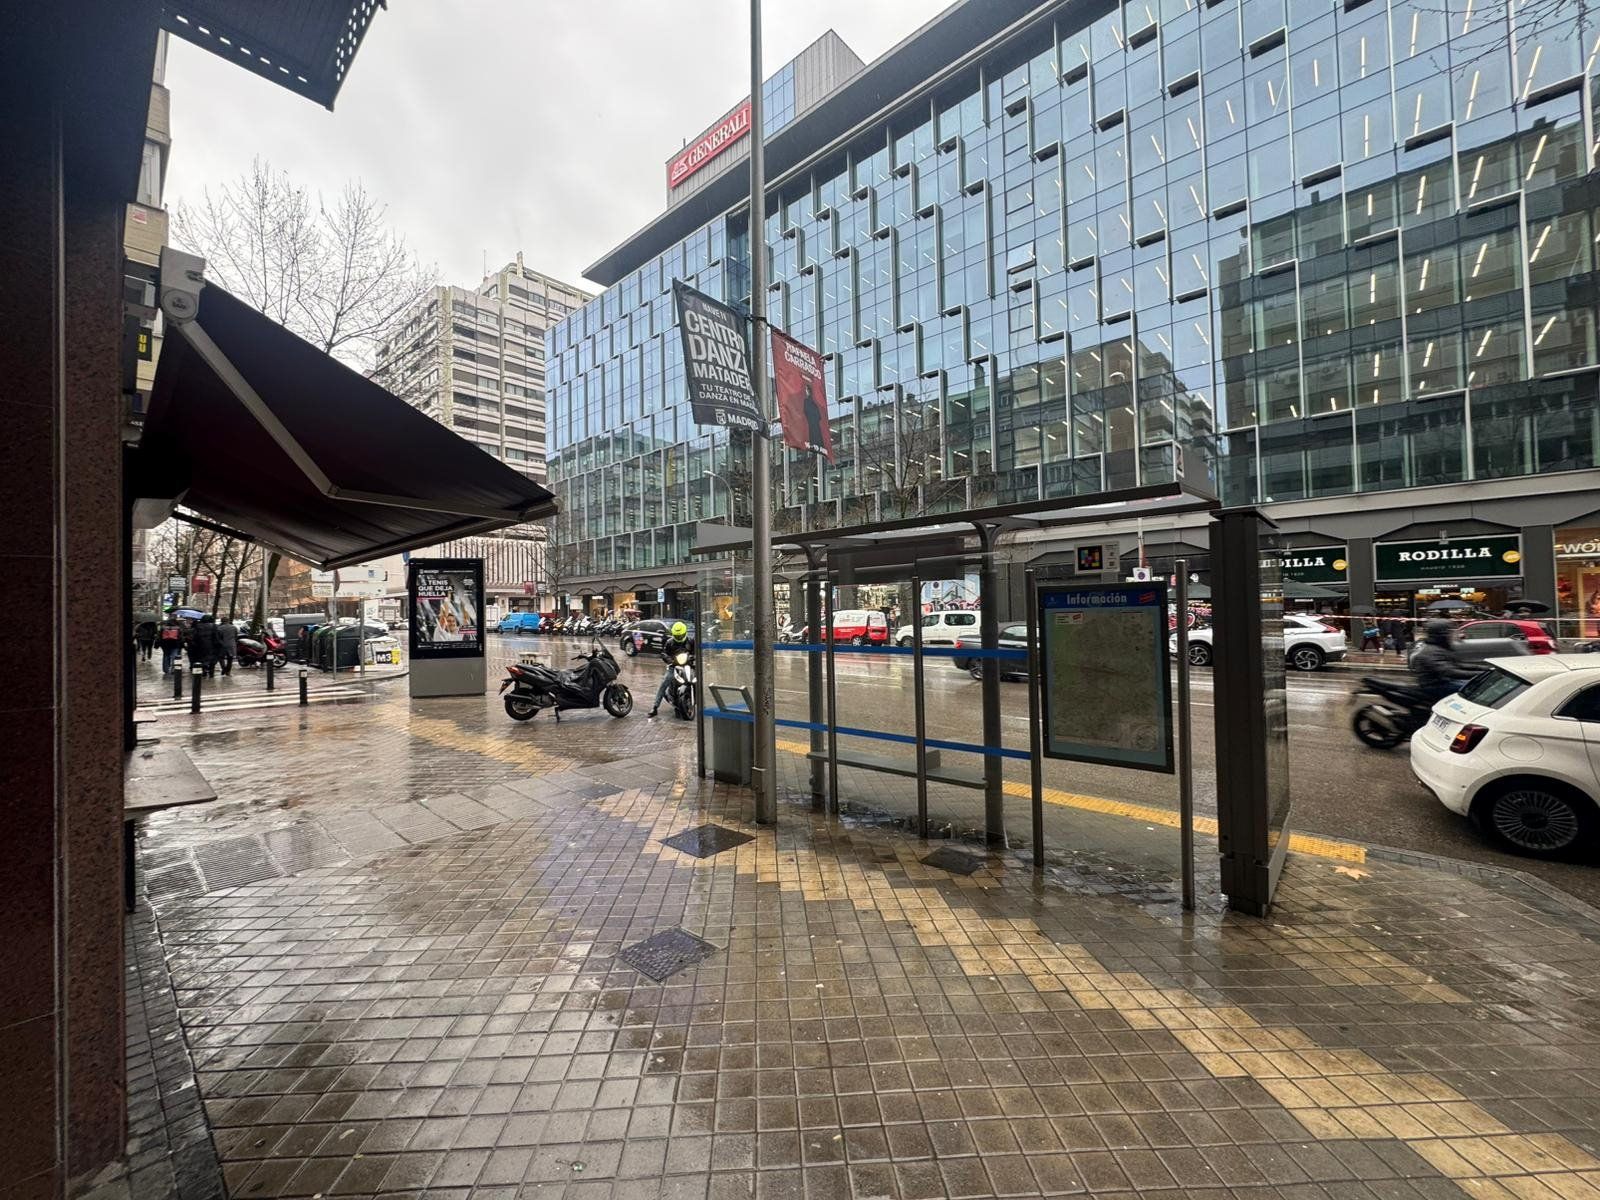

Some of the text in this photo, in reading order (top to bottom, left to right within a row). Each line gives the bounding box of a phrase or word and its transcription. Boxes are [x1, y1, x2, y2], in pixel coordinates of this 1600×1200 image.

[687, 108, 748, 167] GENERALI
[698, 391, 728, 402] DANZA
[700, 383, 713, 391] TU
[714, 385, 742, 399] TEATRO
[727, 413, 759, 431] MADRID
[1398, 547, 1492, 562] RODILLA
[1066, 593, 1128, 606] Información
[377, 653, 392, 662] M3
